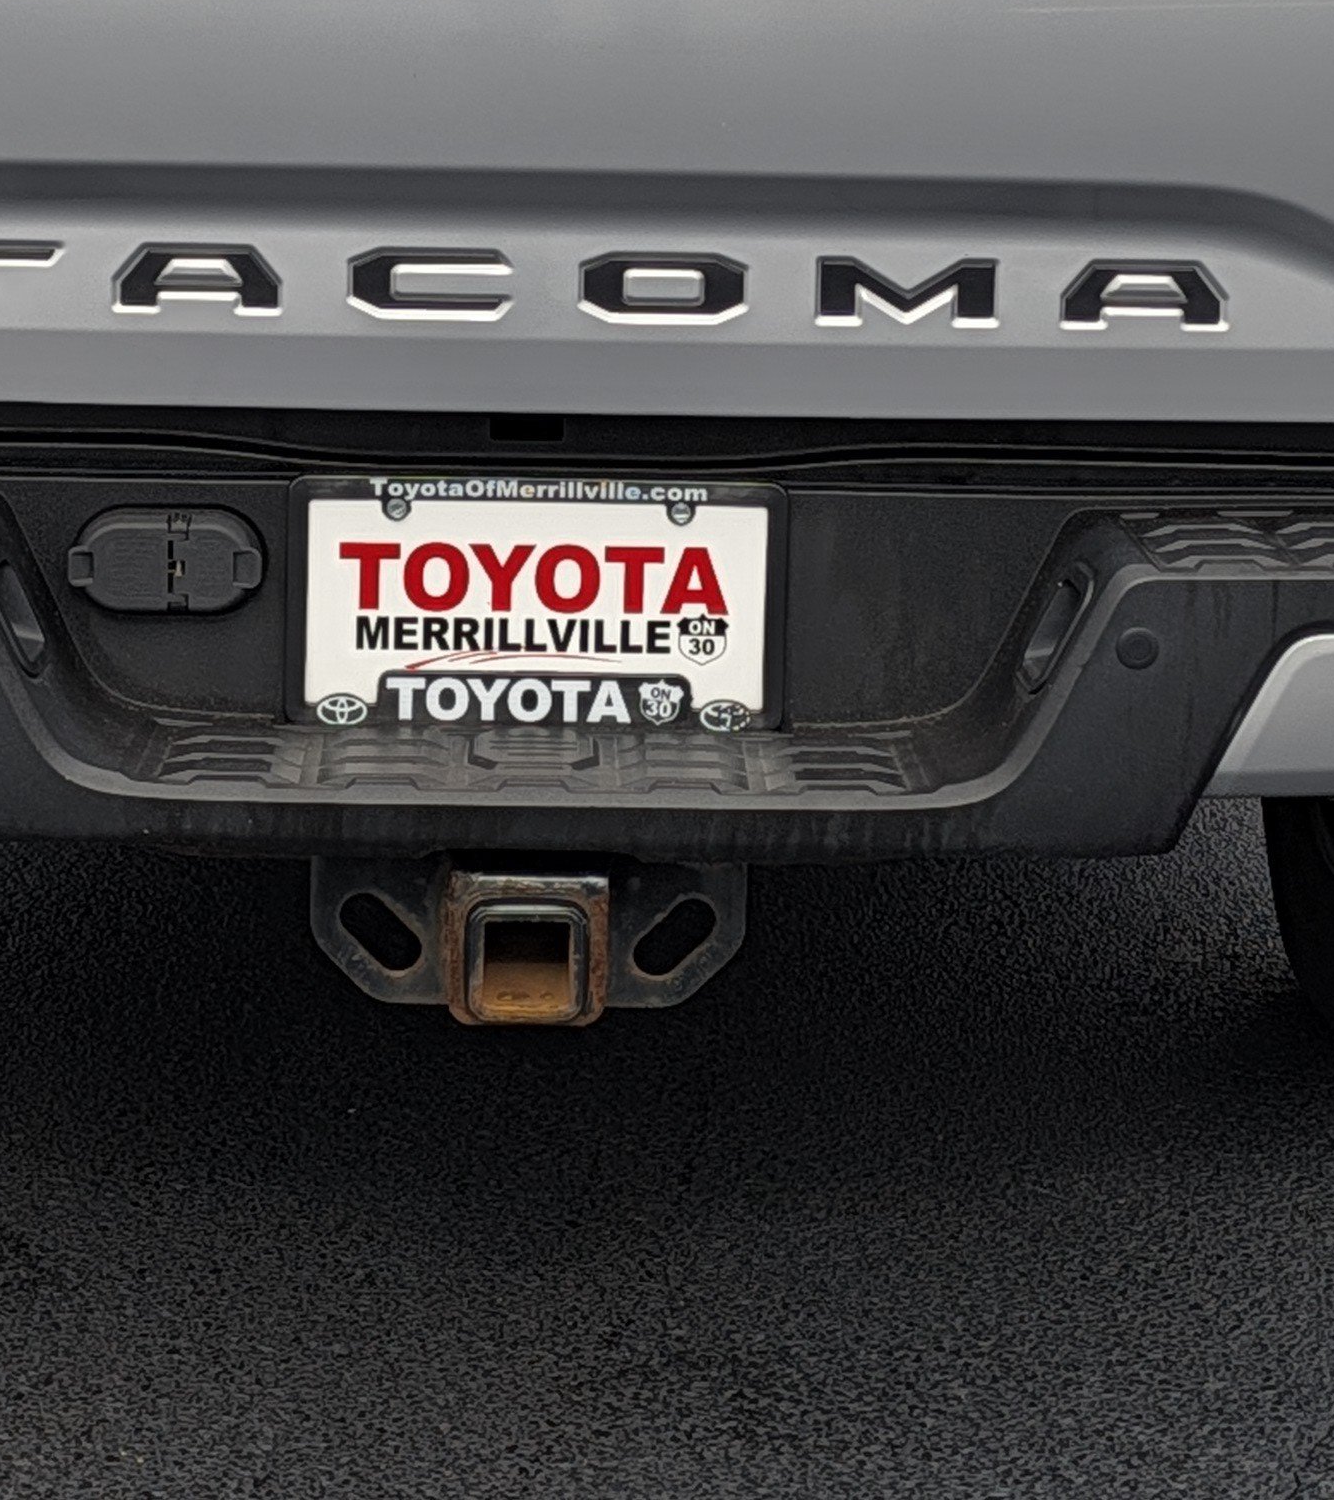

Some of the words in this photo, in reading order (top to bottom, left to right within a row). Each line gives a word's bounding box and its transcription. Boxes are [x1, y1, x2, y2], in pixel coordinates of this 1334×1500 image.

[369, 478, 709, 502] ToyotaOfMerrillville.com
[338, 541, 729, 616] TOYOTA
[355, 615, 672, 655] MERRILLVILLE
[688, 620, 716, 635] ON
[688, 638, 715, 655] 30
[385, 676, 632, 725] TOYOTA
[650, 687, 672, 700] ON
[645, 701, 672, 718] 30
